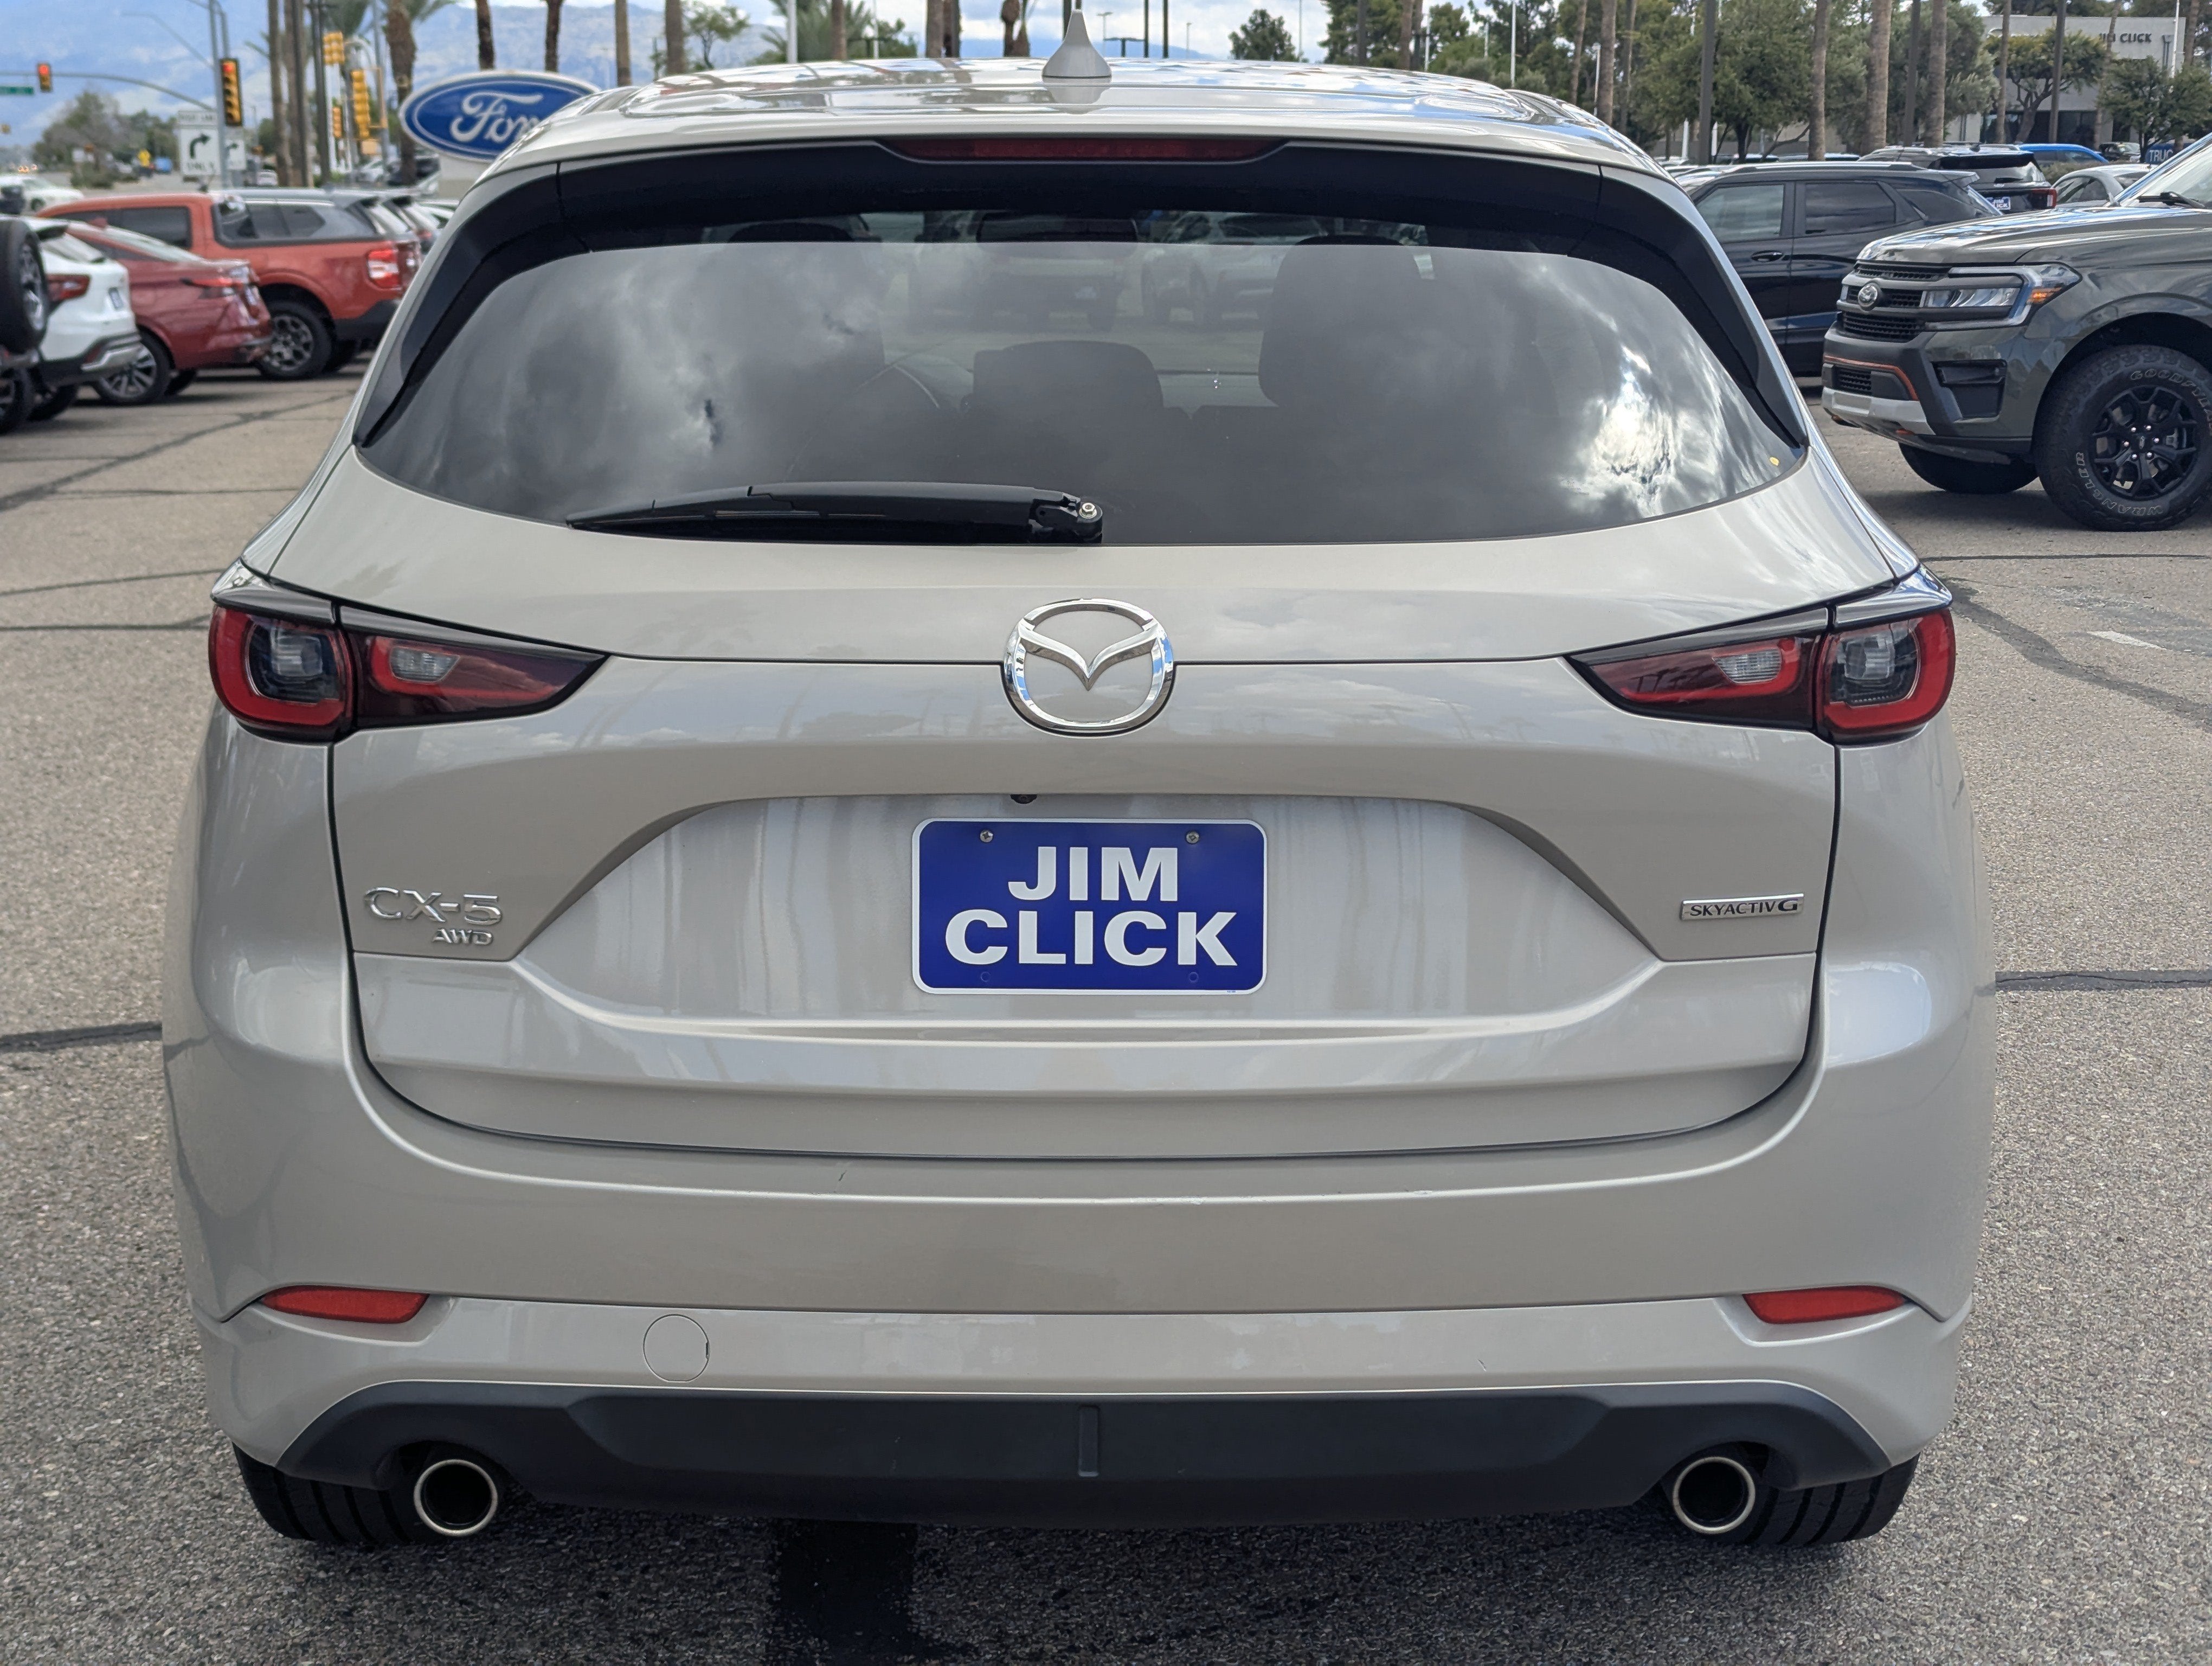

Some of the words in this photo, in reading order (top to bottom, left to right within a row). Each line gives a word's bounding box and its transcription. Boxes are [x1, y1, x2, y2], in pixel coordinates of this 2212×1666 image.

[450, 91, 542, 143] For
[2076, 452, 2163, 516] WRANGLER
[1008, 846, 1178, 901] JIM
[363, 887, 502, 926] CX-5
[432, 927, 494, 945] AWD
[945, 909, 1238, 966] CLICK
